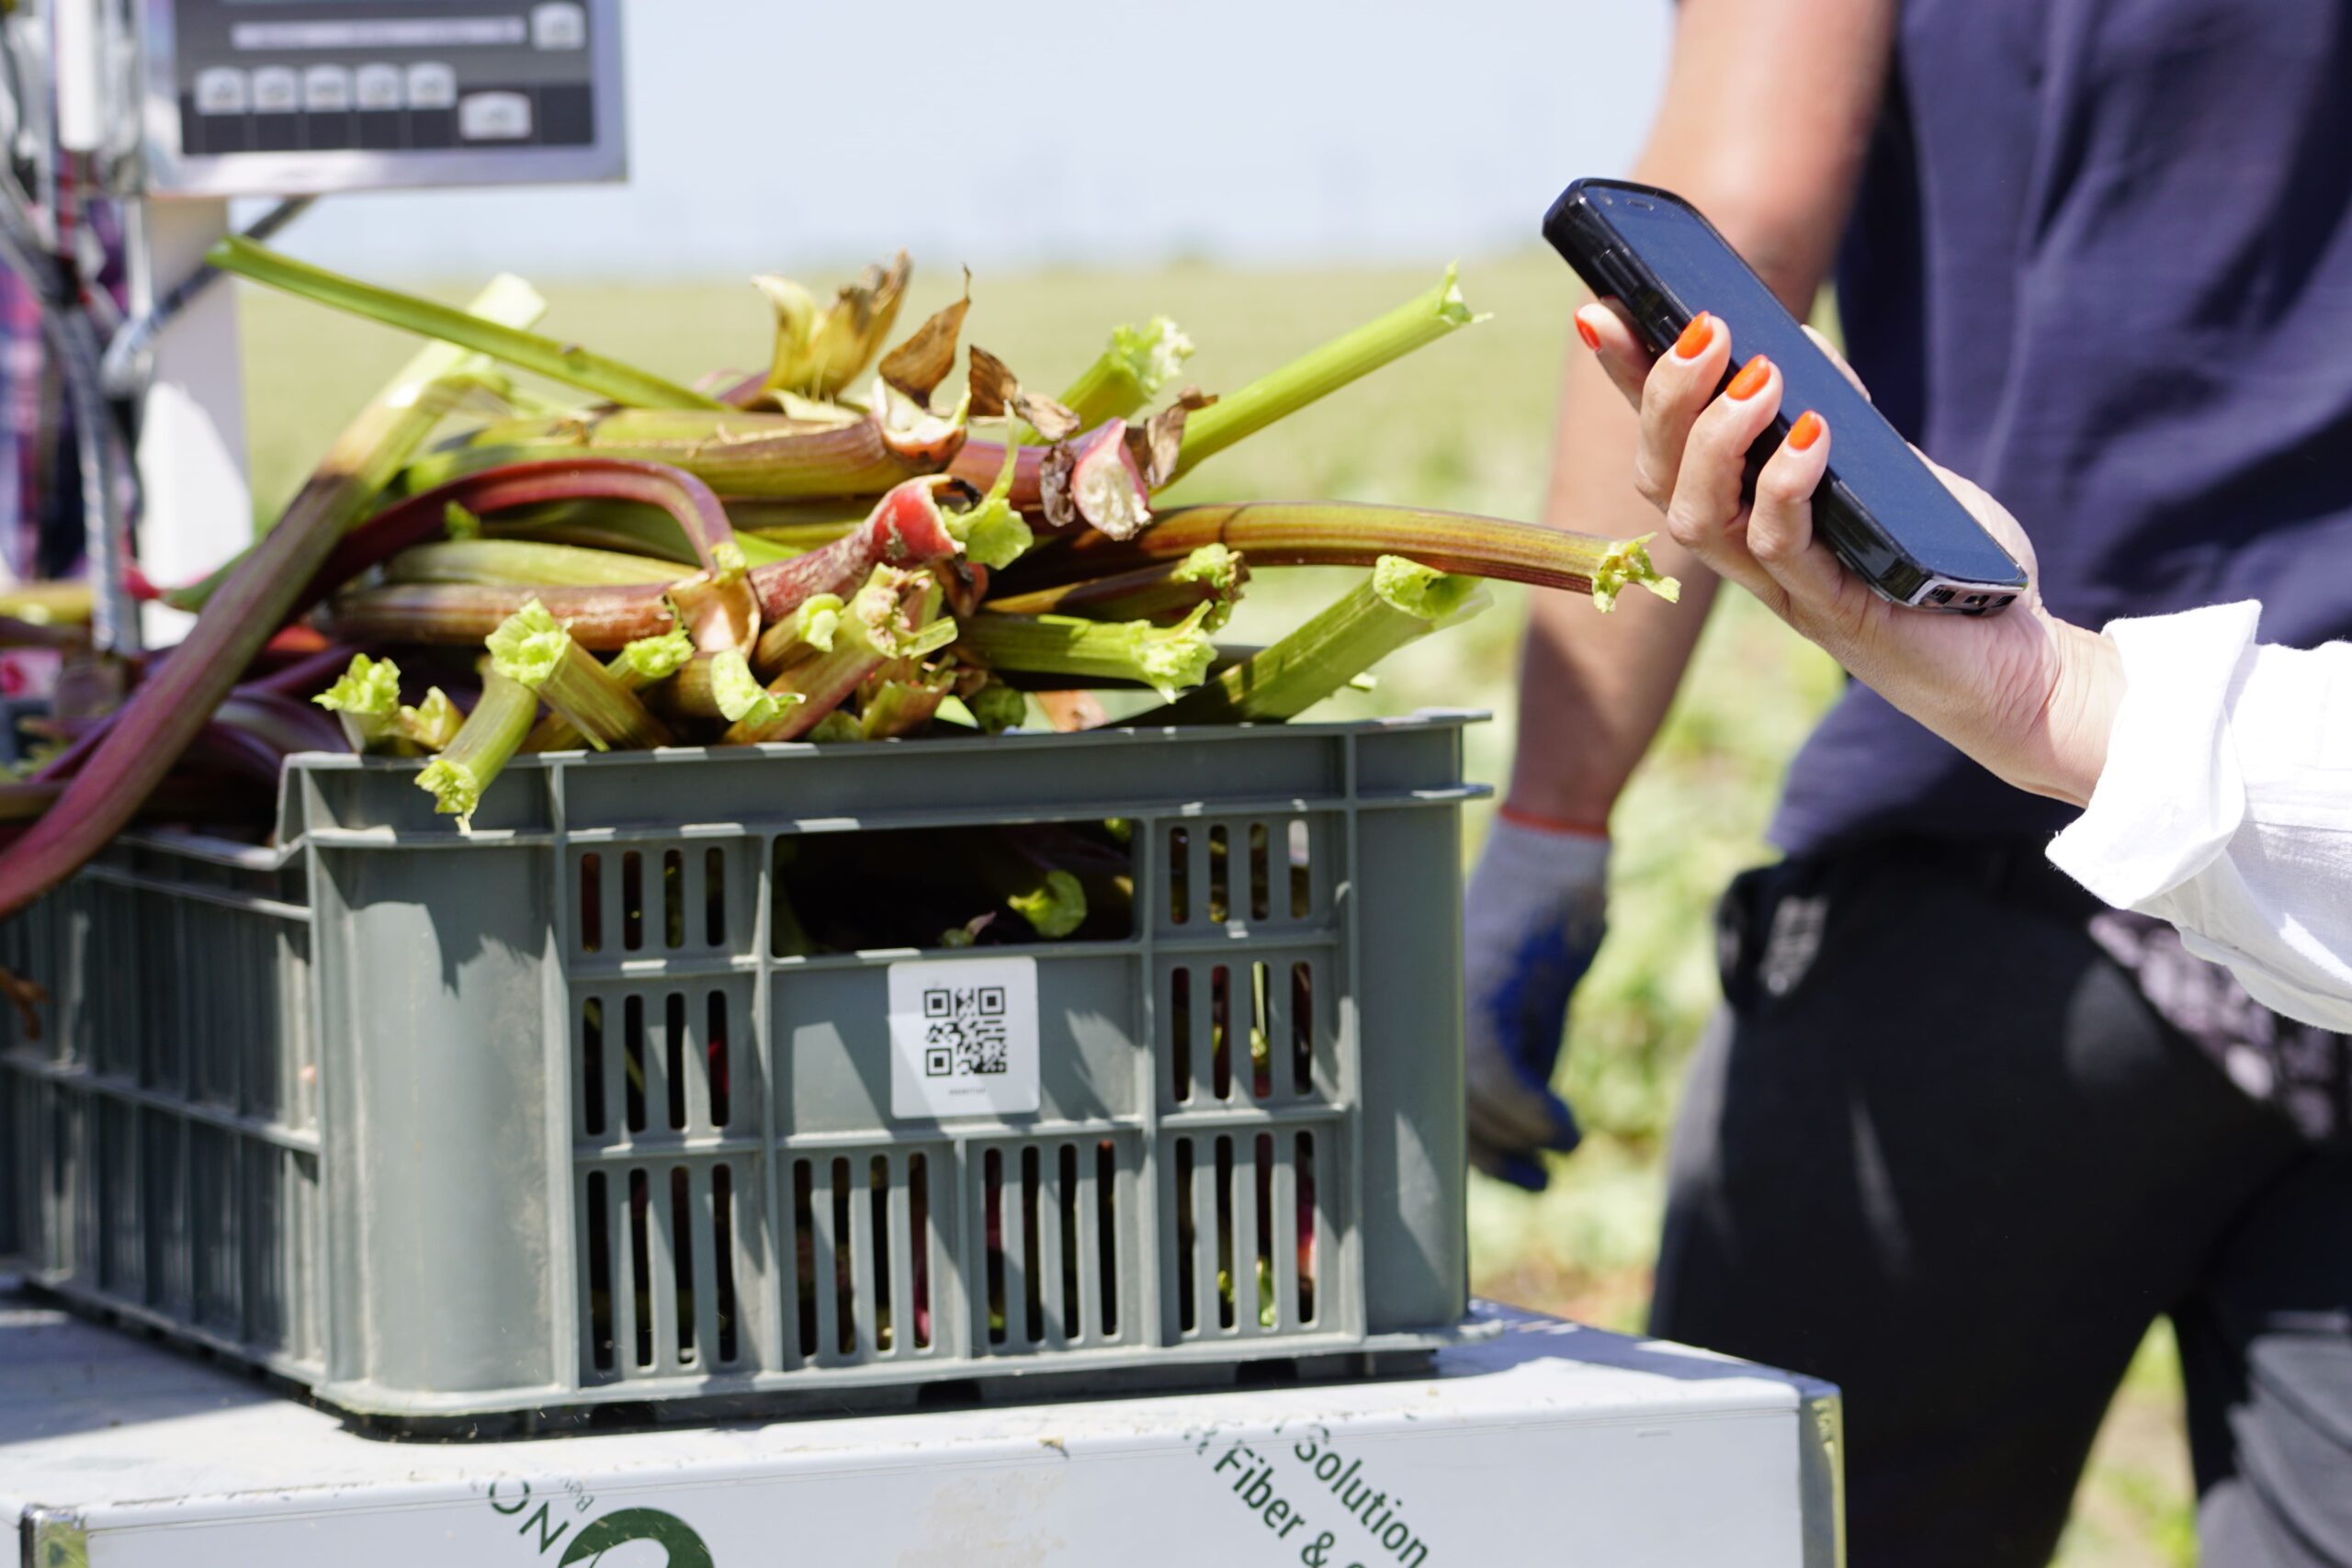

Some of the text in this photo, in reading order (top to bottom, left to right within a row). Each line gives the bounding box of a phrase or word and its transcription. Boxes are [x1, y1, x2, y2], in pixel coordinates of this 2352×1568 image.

[1213, 1440, 1336, 1568] Fiber &
[1295, 1424, 1429, 1568] Solution
